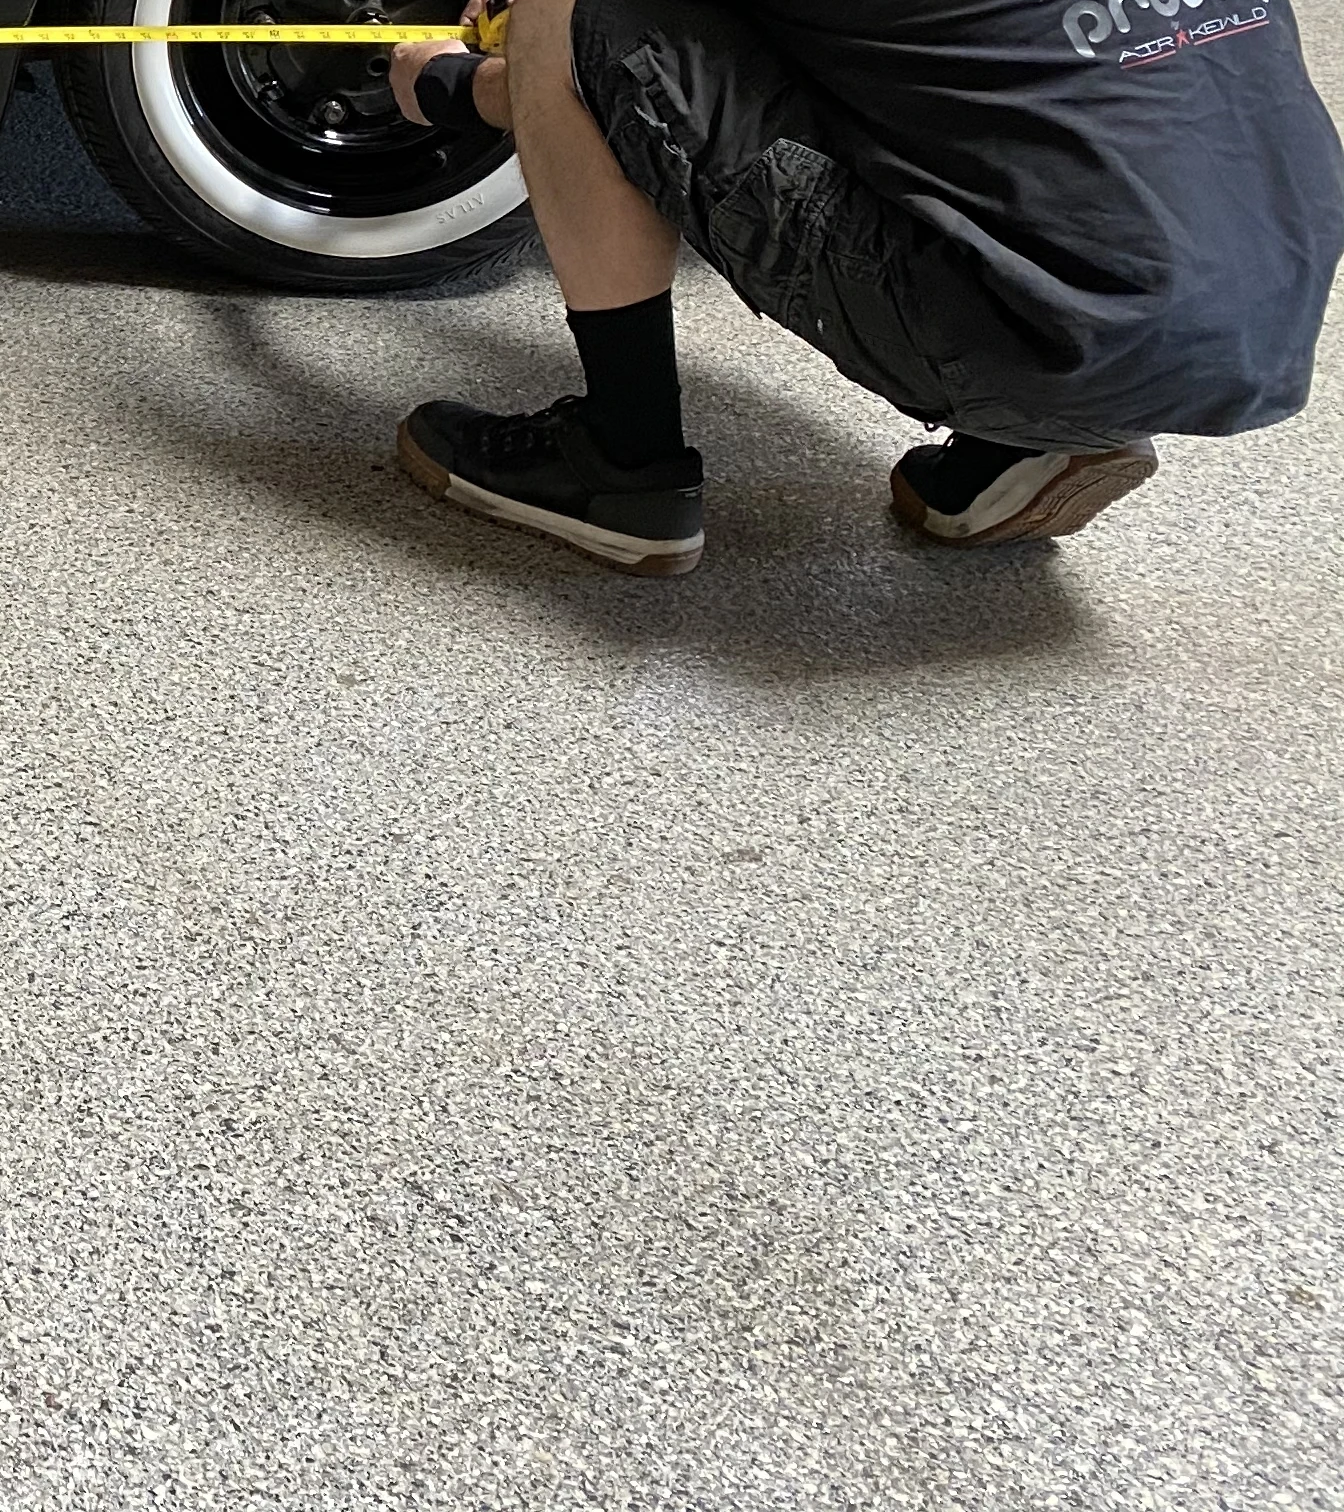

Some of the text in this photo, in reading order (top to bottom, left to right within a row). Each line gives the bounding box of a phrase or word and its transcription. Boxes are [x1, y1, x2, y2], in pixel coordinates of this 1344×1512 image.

[1119, 6, 1268, 63] AIR KEWLD
[436, 192, 486, 224] ATLAS
